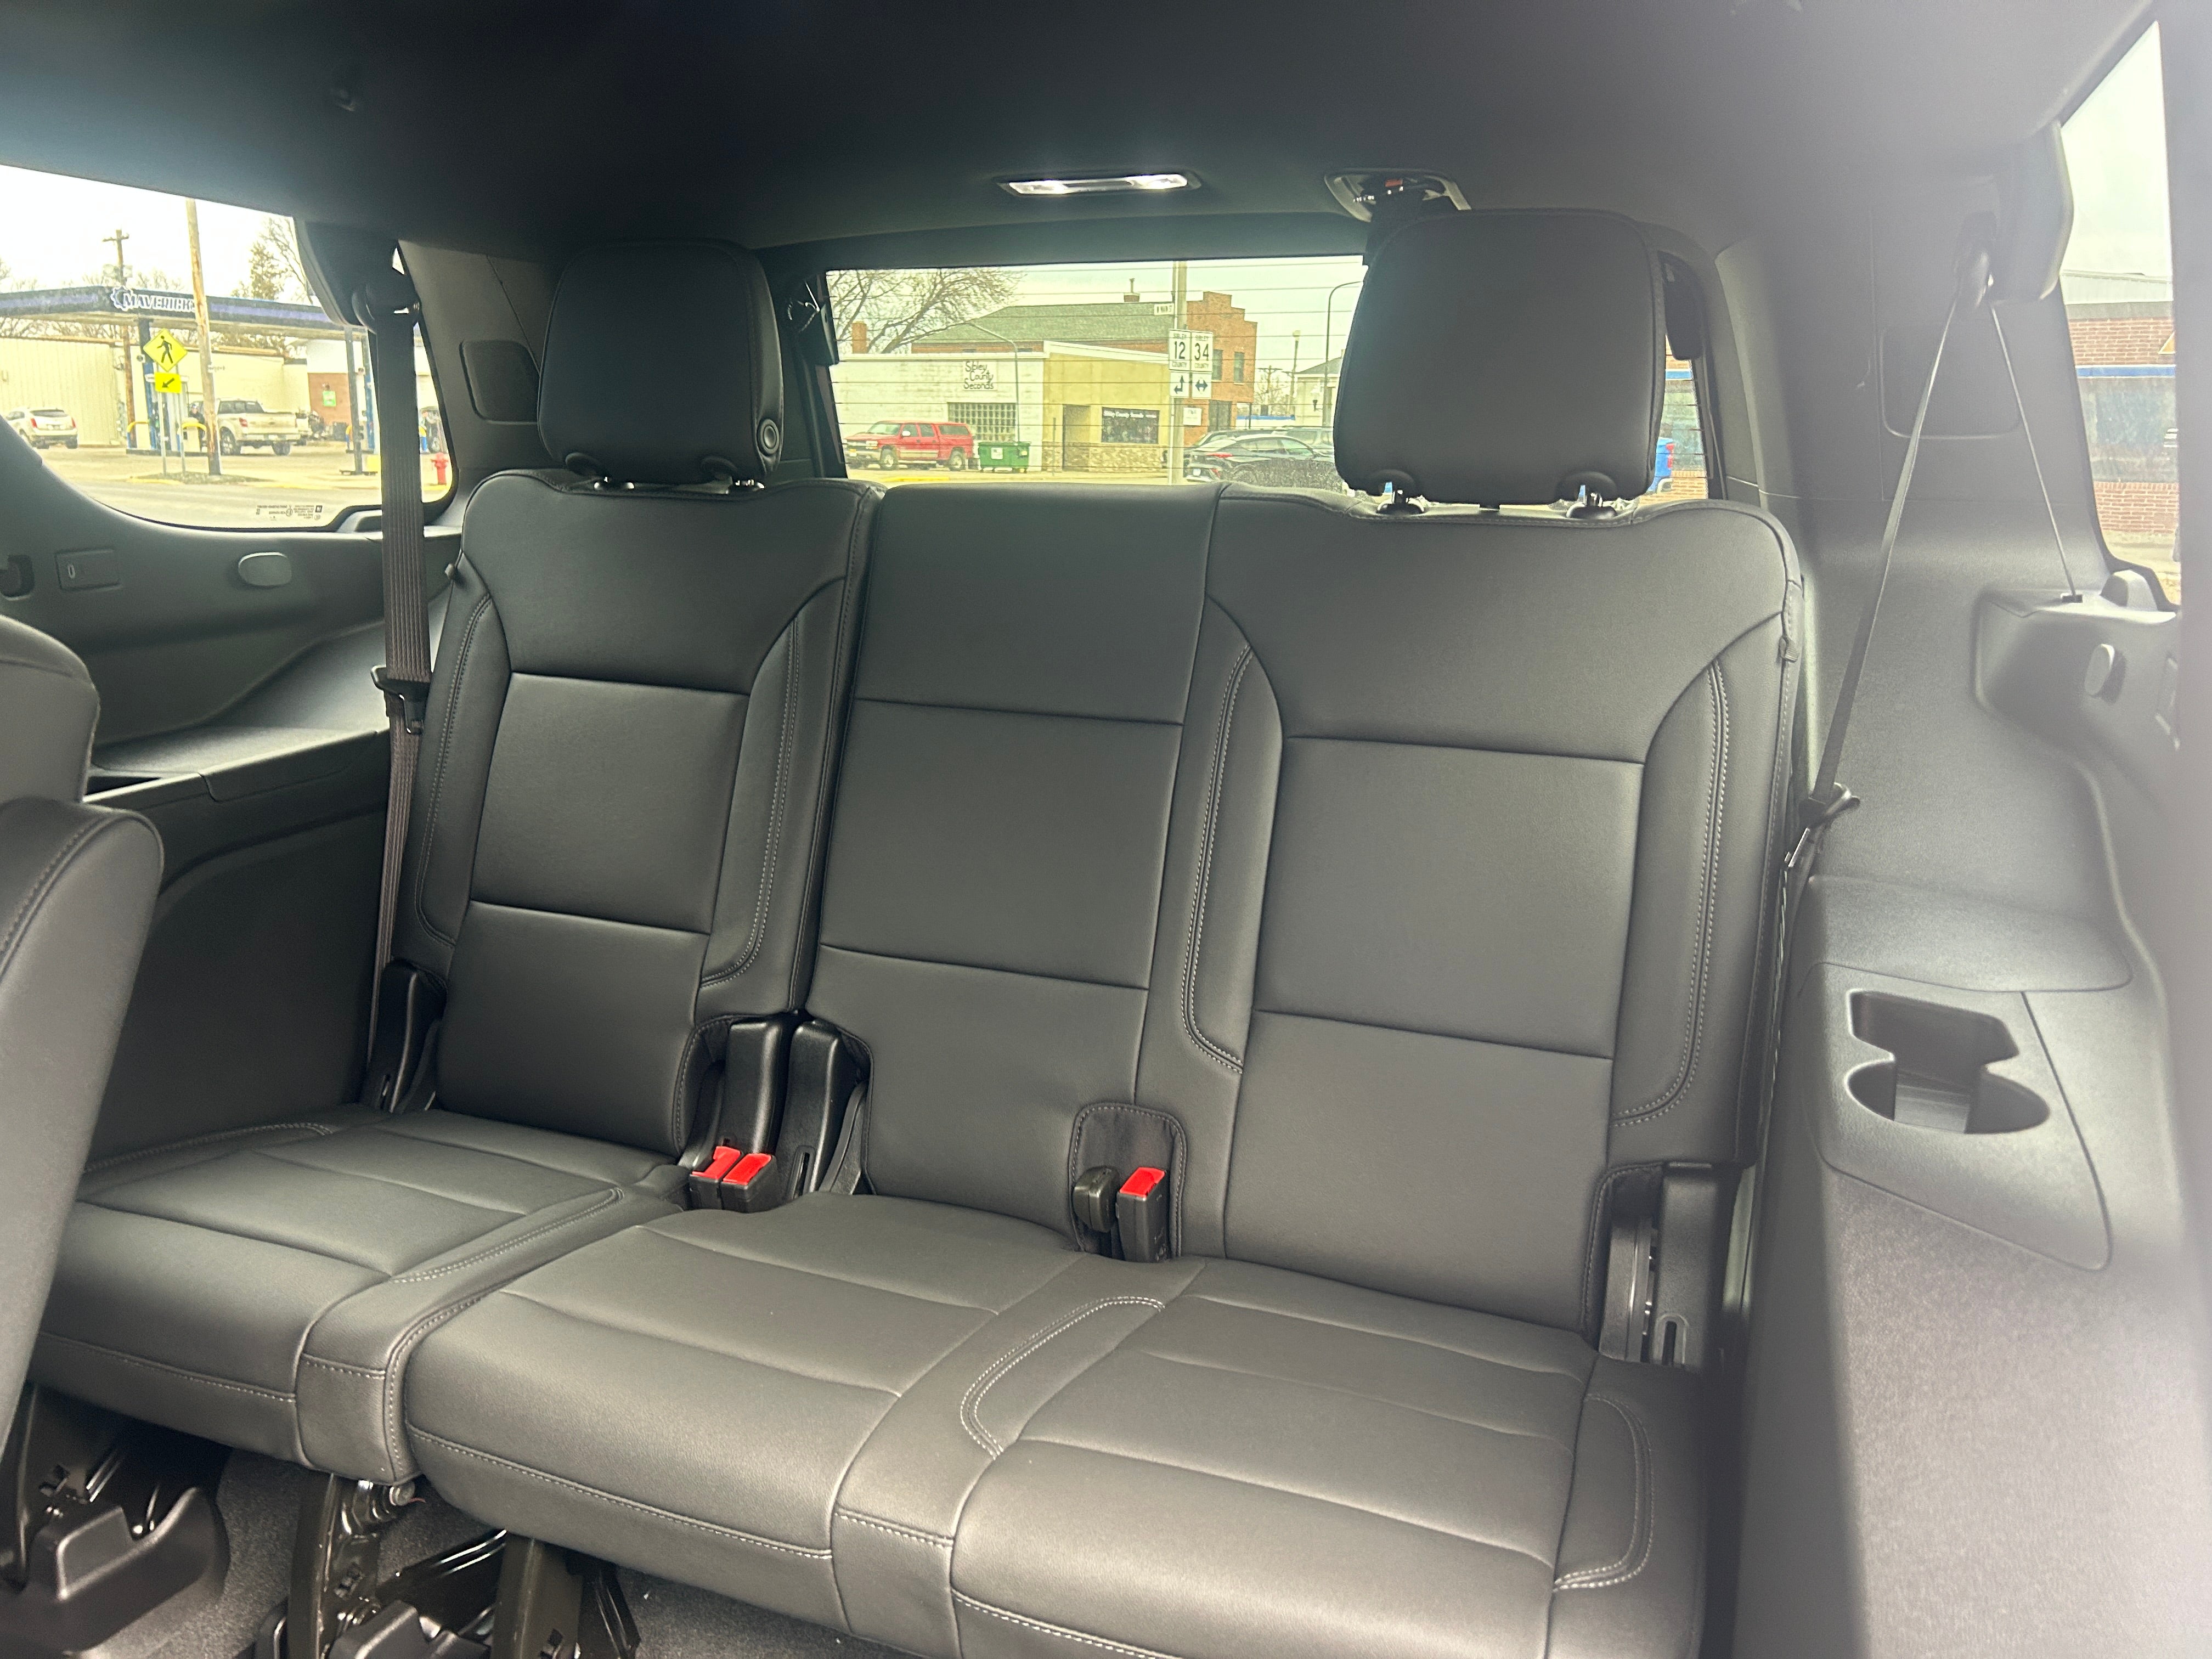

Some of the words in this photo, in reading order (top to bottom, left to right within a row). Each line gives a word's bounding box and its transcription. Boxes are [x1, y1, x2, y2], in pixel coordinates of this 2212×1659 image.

[1174, 341, 1186, 360] 12
[1194, 342, 1209, 362] 34
[964, 359, 988, 374] Sibley
[963, 377, 994, 390] Seconds
[969, 370, 994, 383] County
